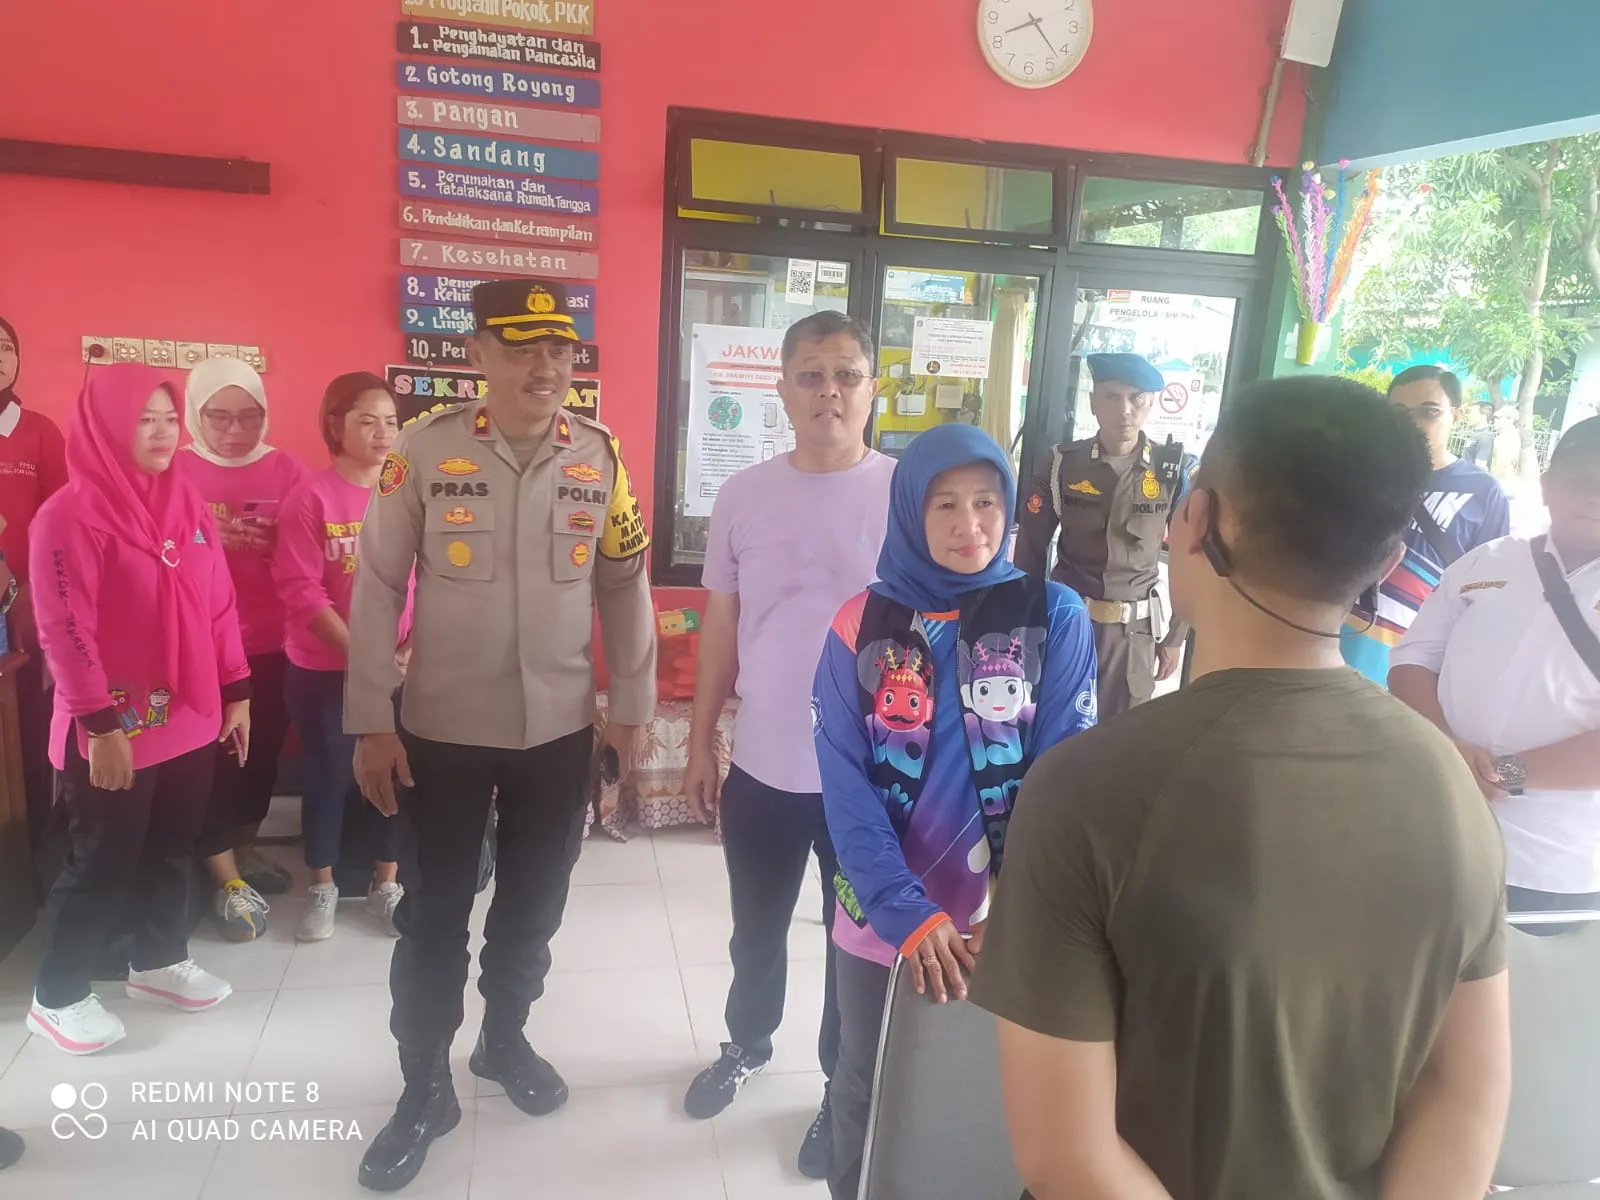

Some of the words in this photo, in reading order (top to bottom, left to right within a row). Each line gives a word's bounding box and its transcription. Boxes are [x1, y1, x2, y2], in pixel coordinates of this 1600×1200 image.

[501, 0, 551, 23] Pokok
[554, 2, 590, 25] PKK
[988, 11, 998, 24] 9
[1068, 20, 1079, 34] 3
[410, 26, 428, 49] 1.
[439, 25, 547, 49] Penghayatan
[552, 38, 585, 53] dan
[992, 36, 1003, 49] 8
[433, 39, 520, 61] Pengamalan
[525, 48, 595, 70] Pancasila
[1059, 43, 1069, 56] 4
[1006, 53, 1016, 66] 7
[1023, 61, 1034, 75] 6
[1045, 58, 1055, 71] 5
[405, 65, 420, 83] 2.
[427, 66, 494, 93] Gotong
[503, 72, 575, 102] Royong
[406, 100, 423, 119] 3.
[432, 101, 519, 130] Pangan
[407, 133, 426, 155] 4.
[433, 136, 546, 173] Sandang
[408, 171, 426, 189] 5.
[438, 170, 514, 190] Perumahan
[521, 178, 546, 194] dan
[436, 182, 513, 202] Tatalaksana
[403, 206, 419, 223] 6.
[422, 208, 490, 231] Pendidikan
[411, 243, 427, 261] 7.
[441, 244, 567, 270] Kesehatan
[406, 276, 426, 298] 8.
[1140, 295, 1170, 304] RUANG
[406, 308, 425, 327] 9.
[1110, 308, 1158, 318] PENGELOLA
[572, 350, 590, 364] at
[721, 344, 782, 360] JAKW
[430, 482, 489, 498] PRAS
[558, 486, 607, 505] POLRI
[611, 511, 630, 527] KA
